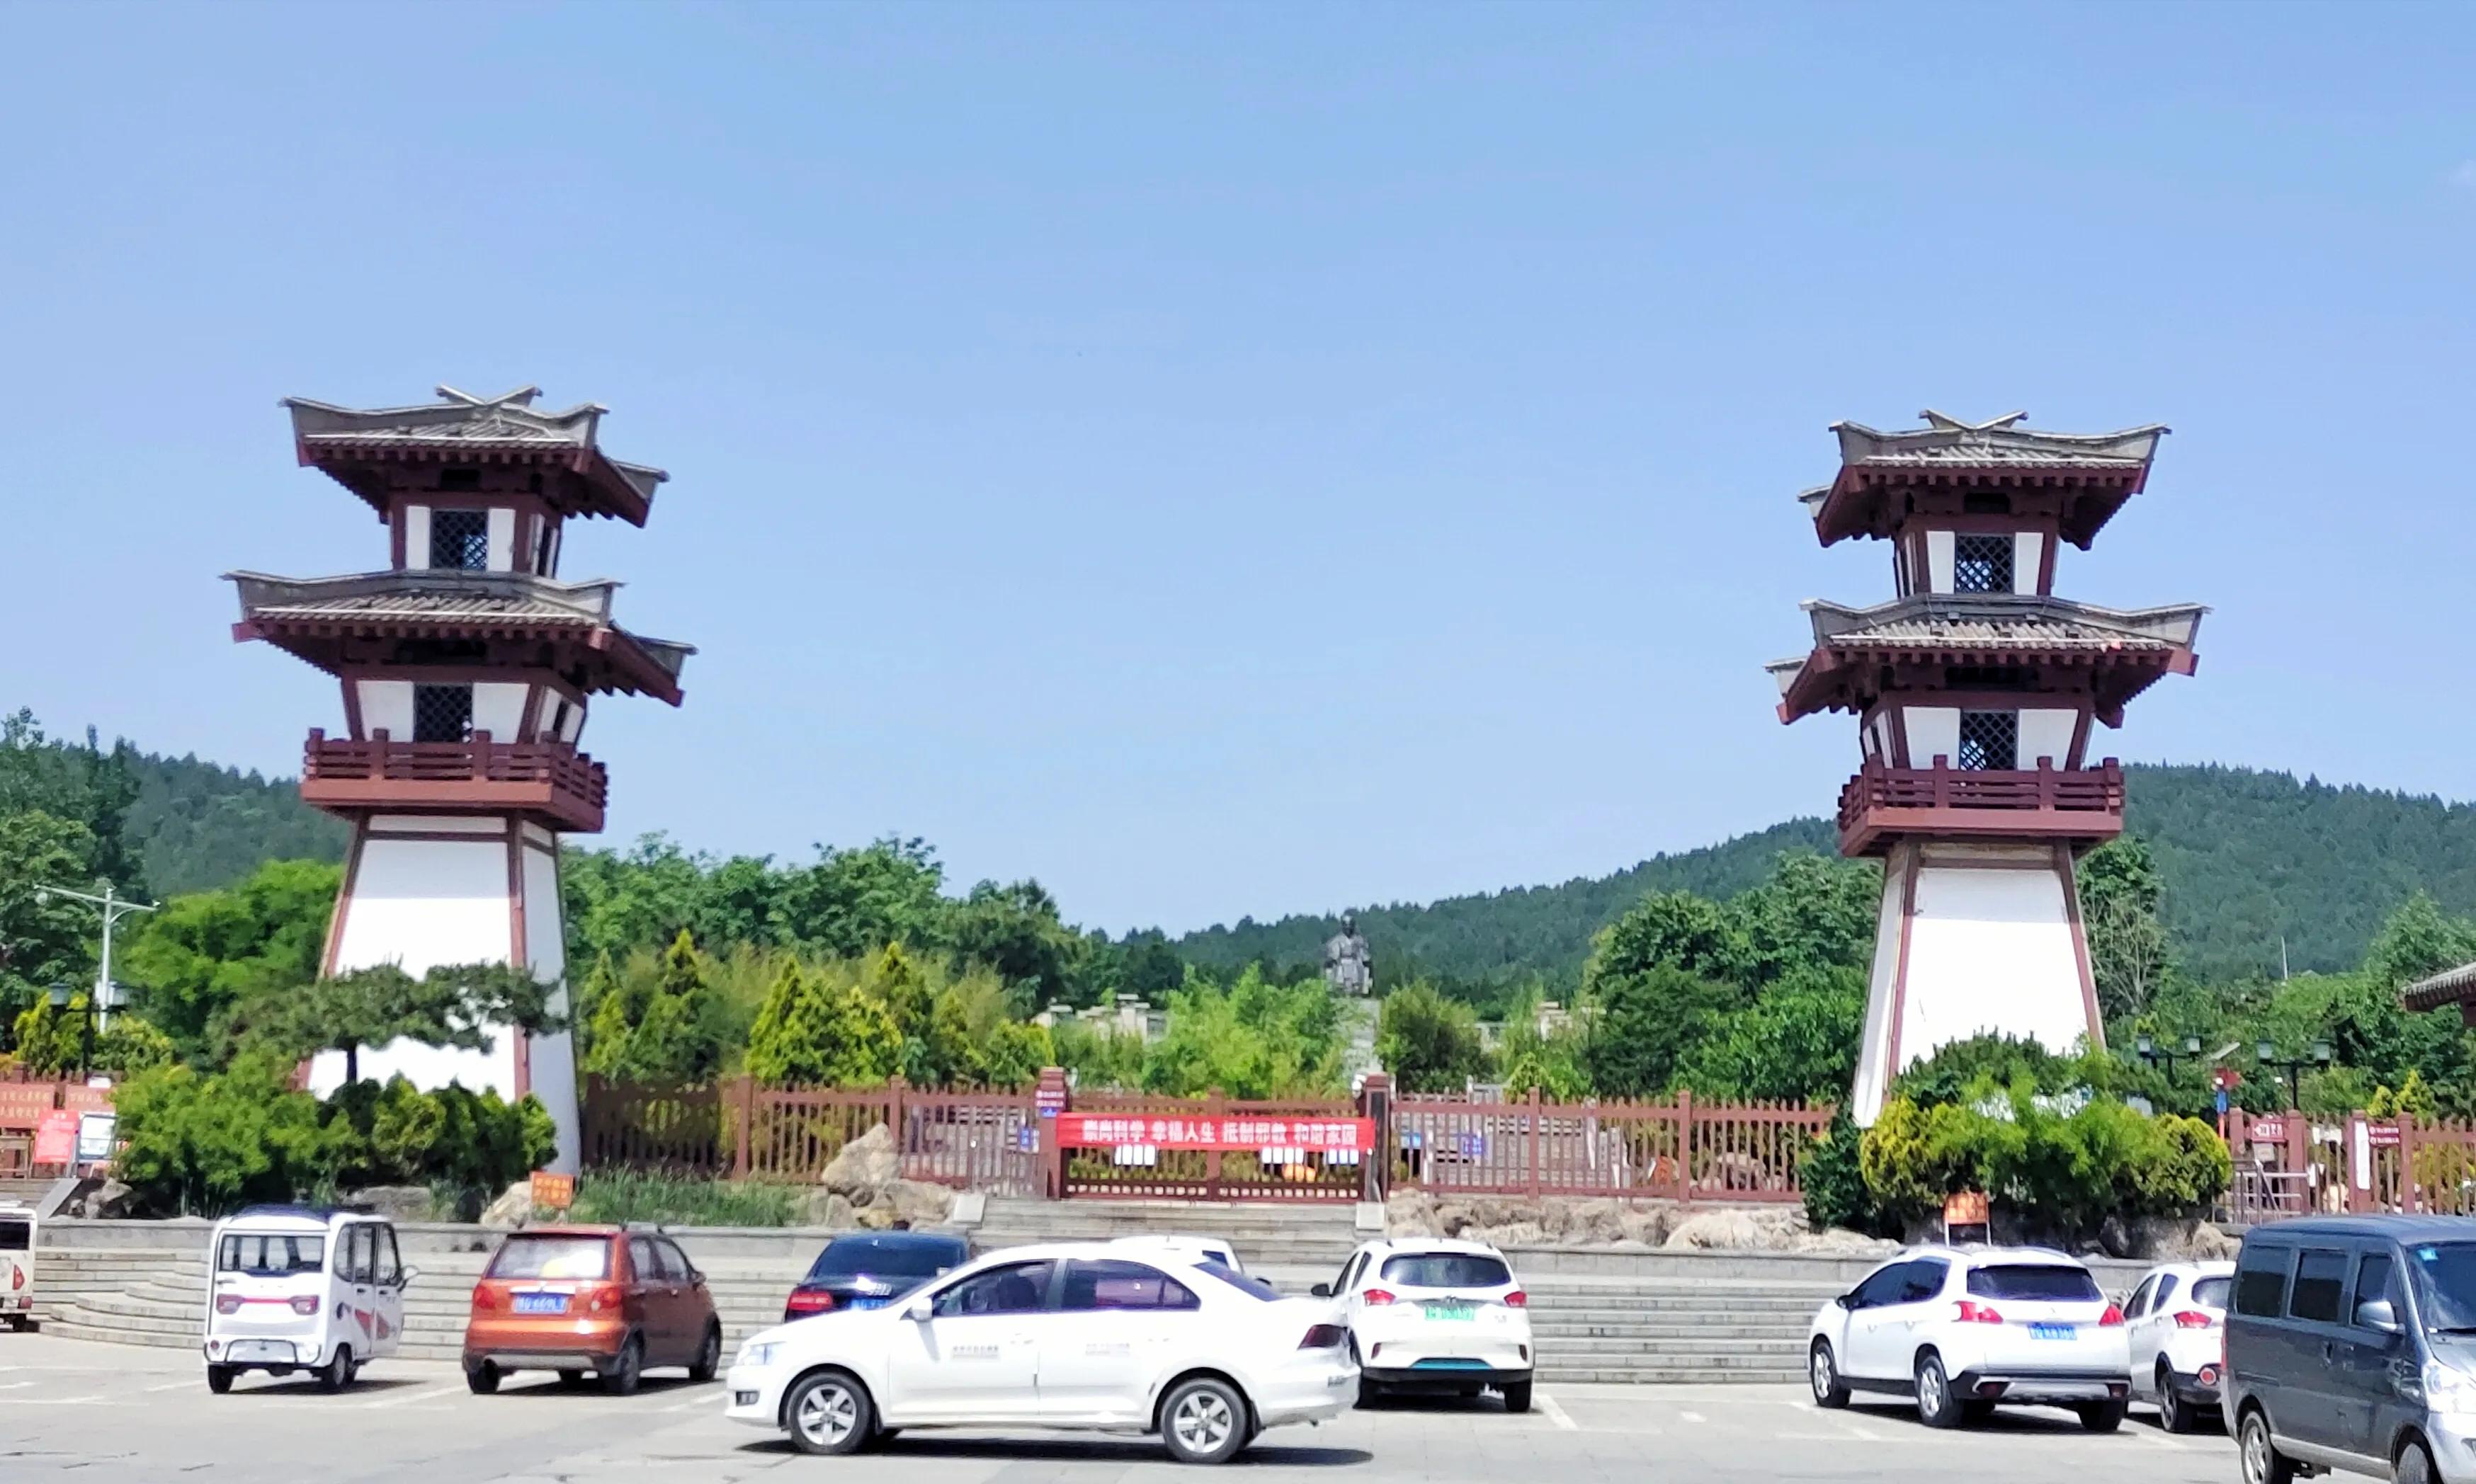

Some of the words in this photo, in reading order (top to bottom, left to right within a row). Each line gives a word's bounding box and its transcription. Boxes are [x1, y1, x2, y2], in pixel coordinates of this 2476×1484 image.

[1083, 1119, 1145, 1143] 崇尚科学
[1152, 1120, 1216, 1143] 幸福人生
[1222, 1121, 1287, 1144] 抵制邪教
[1294, 1123, 1357, 1146] 和谐家园
